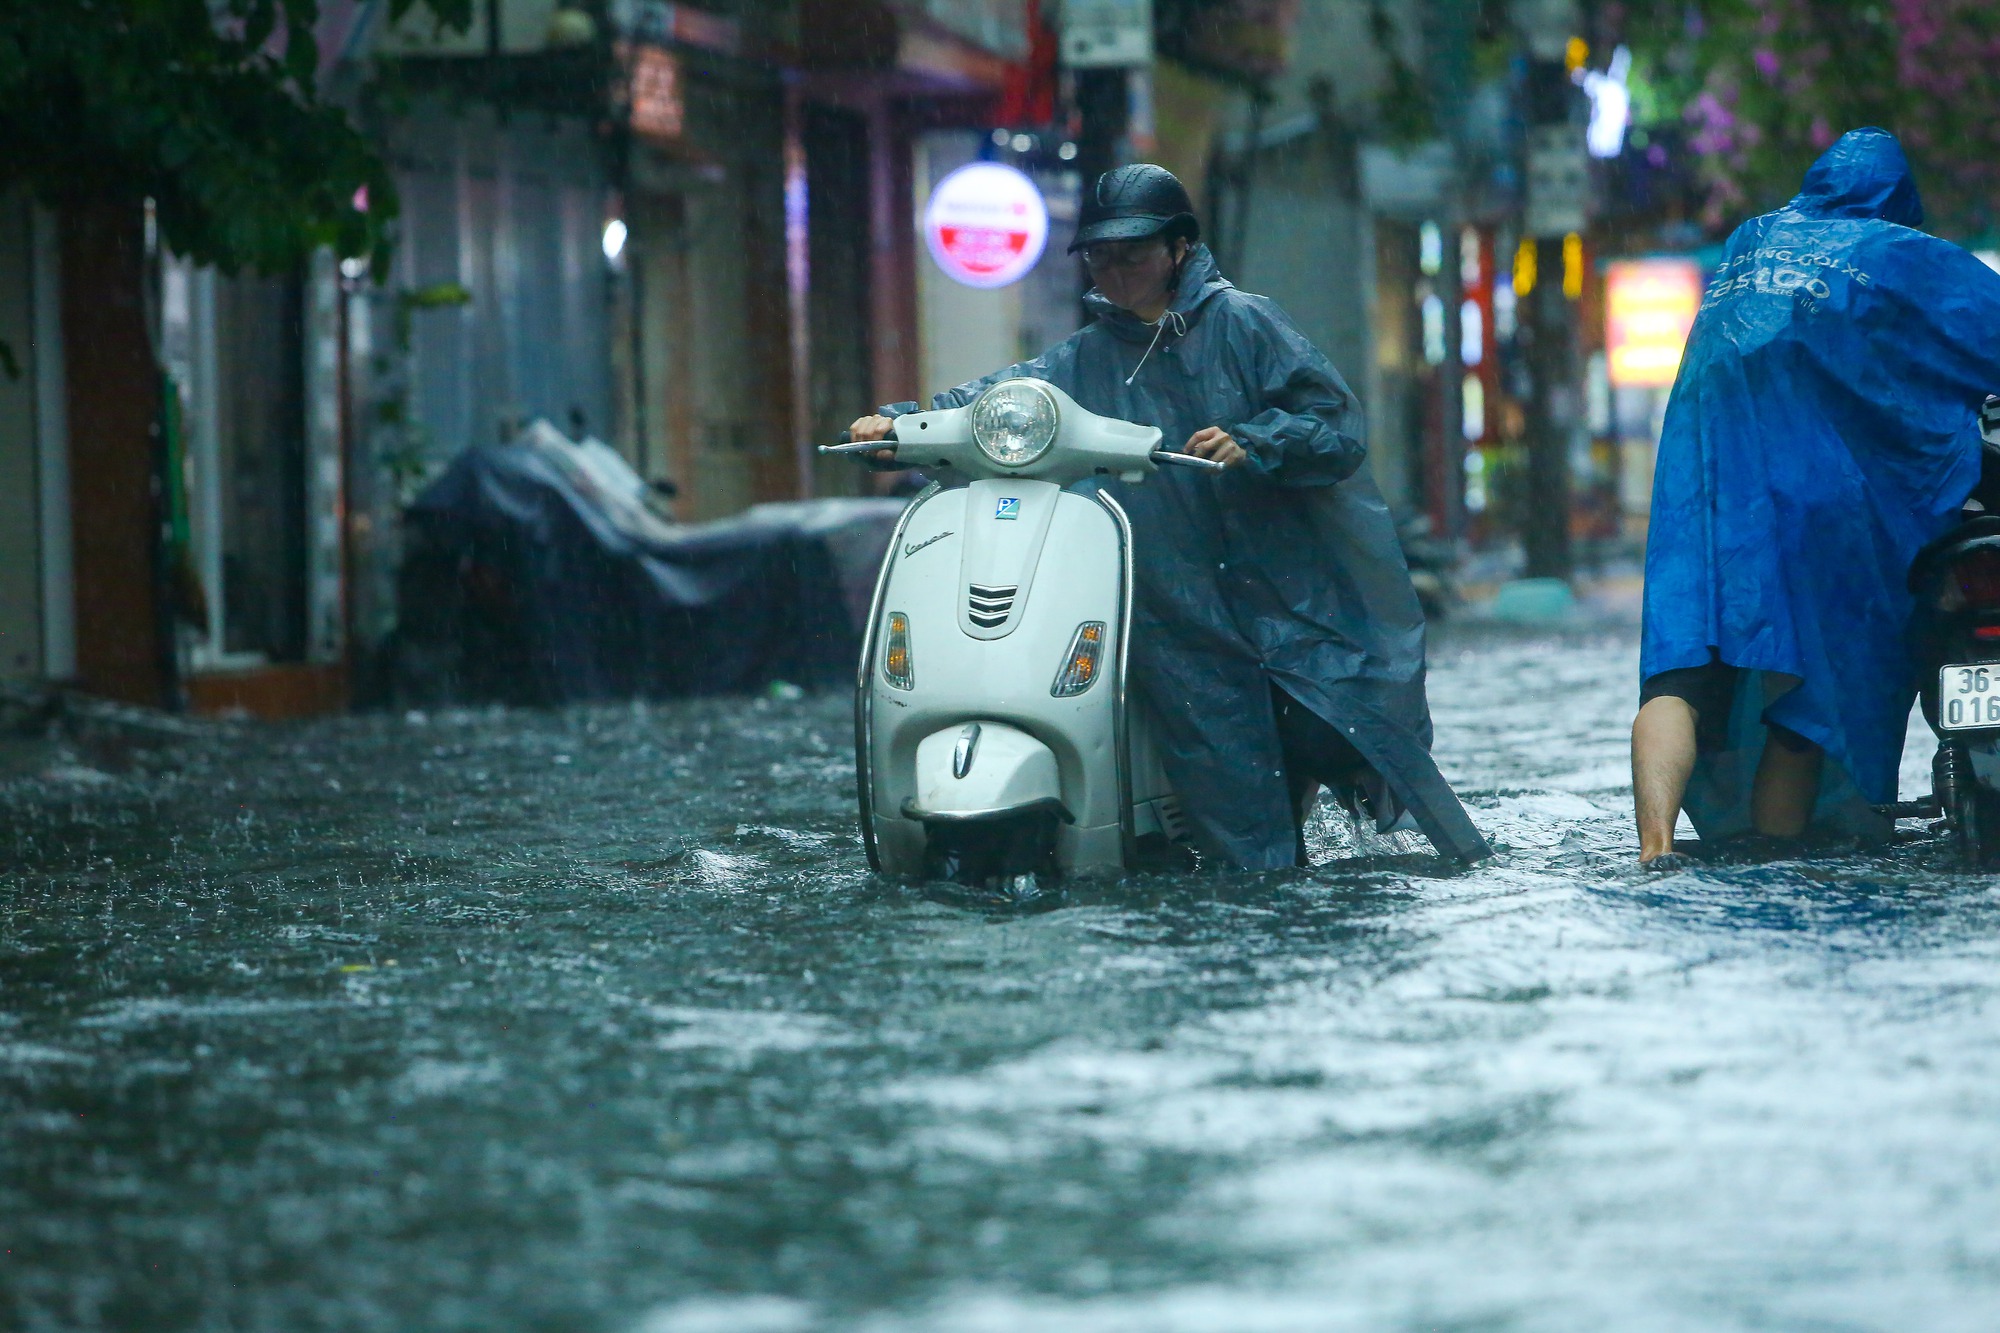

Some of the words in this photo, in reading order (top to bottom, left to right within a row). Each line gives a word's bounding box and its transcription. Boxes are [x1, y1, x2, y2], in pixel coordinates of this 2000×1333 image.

[1841, 262, 1871, 286] XE
[1800, 296, 1820, 315] life
[1948, 695, 2000, 724] 016
